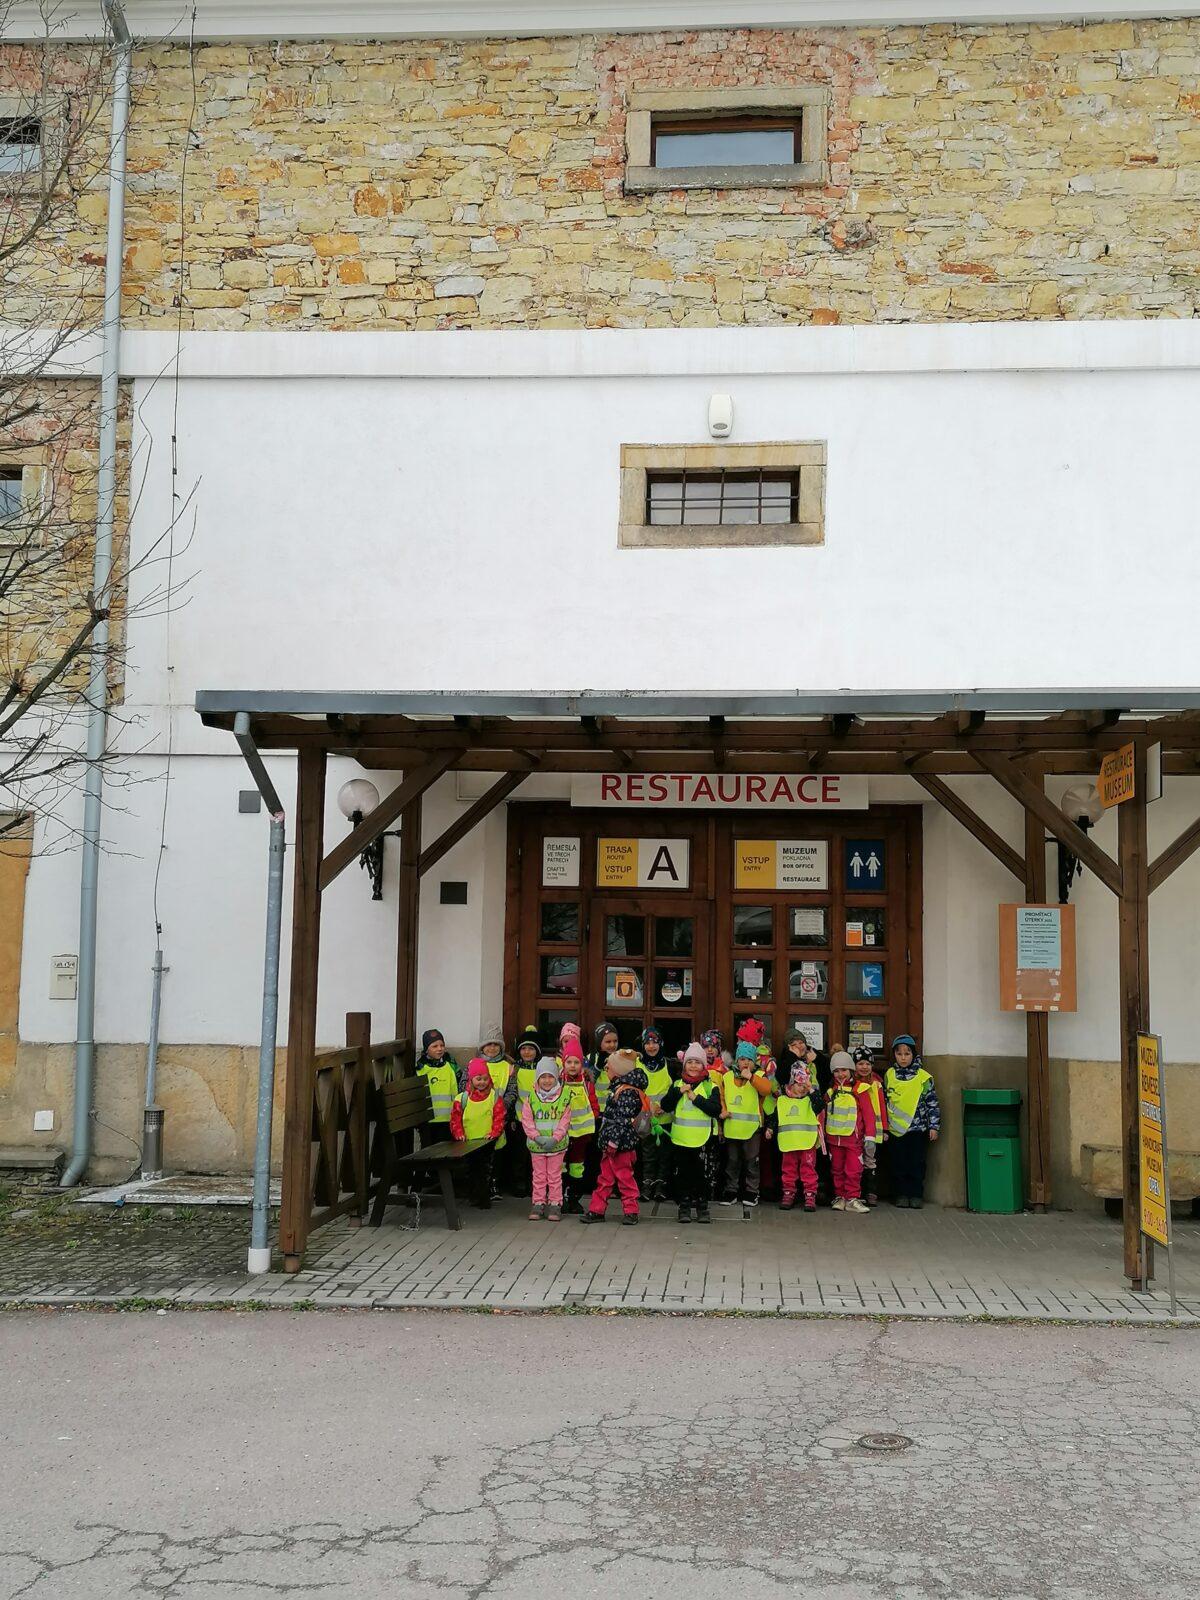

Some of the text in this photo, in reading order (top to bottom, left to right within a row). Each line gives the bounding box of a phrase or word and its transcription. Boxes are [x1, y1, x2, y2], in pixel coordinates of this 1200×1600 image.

[601, 774, 840, 803] RESTAURACE
[1104, 772, 1132, 801] MUSEUM
[606, 846, 632, 854] TRASA
[647, 845, 679, 881] A
[605, 865, 632, 873] VSTUP
